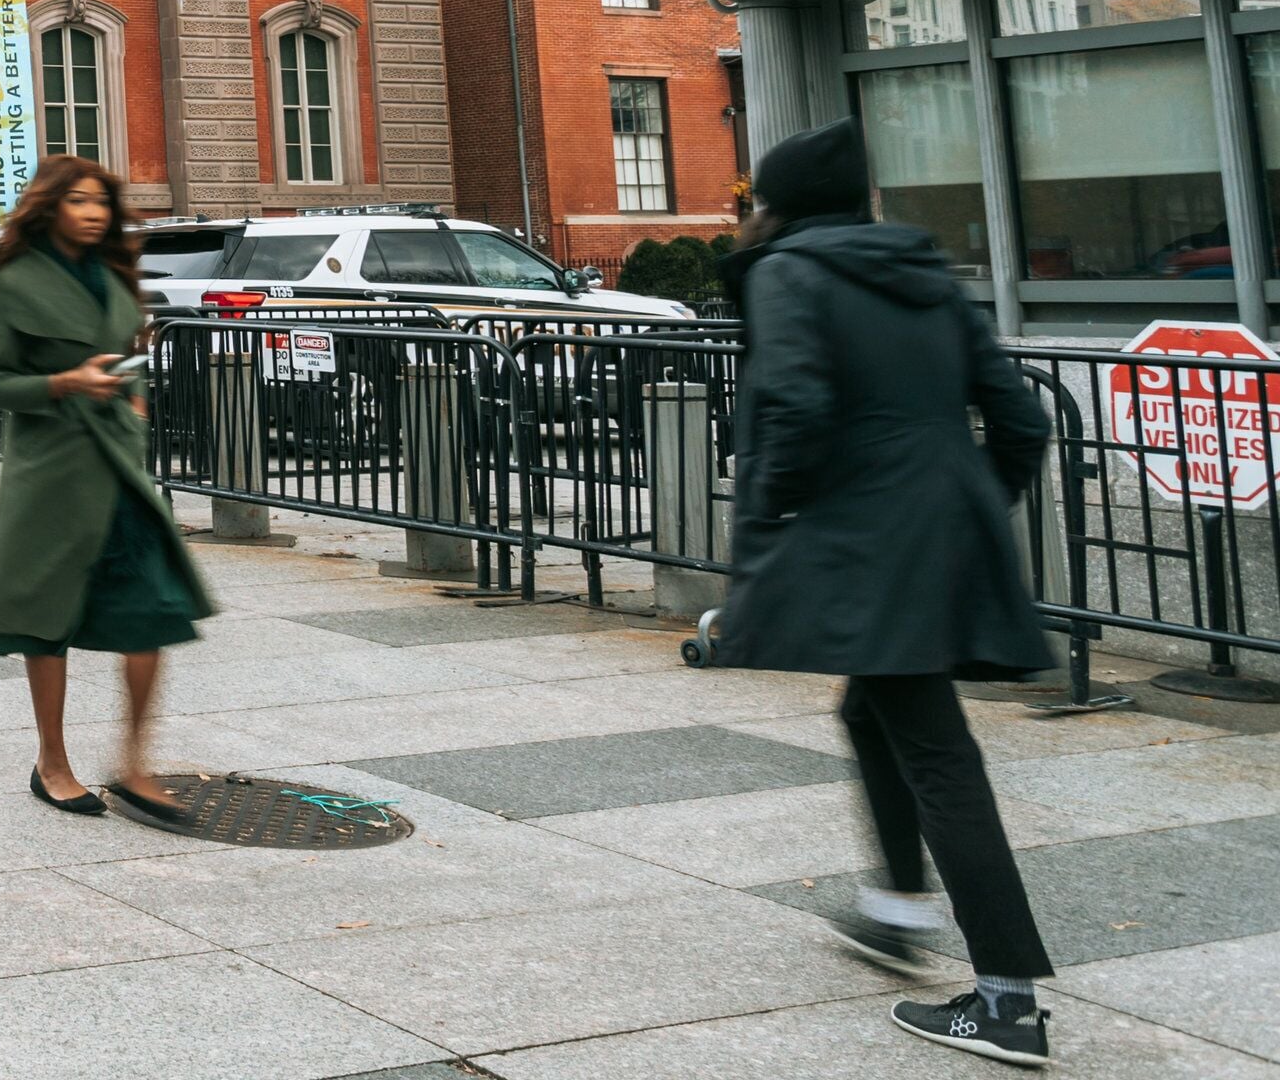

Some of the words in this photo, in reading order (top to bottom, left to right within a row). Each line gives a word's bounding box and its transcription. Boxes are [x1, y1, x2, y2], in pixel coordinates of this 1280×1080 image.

[2, 0, 19, 78] BETTER
[6, 84, 21, 98] A
[269, 286, 294, 298] 4135
[297, 337, 328, 348] DANGER
[295, 351, 332, 360] CONSTRUCTION
[278, 365, 304, 376] ENER
[1139, 346, 1262, 396] STOP
[1144, 428, 1266, 461] VEHICES
[1174, 460, 1239, 487] ONLY
